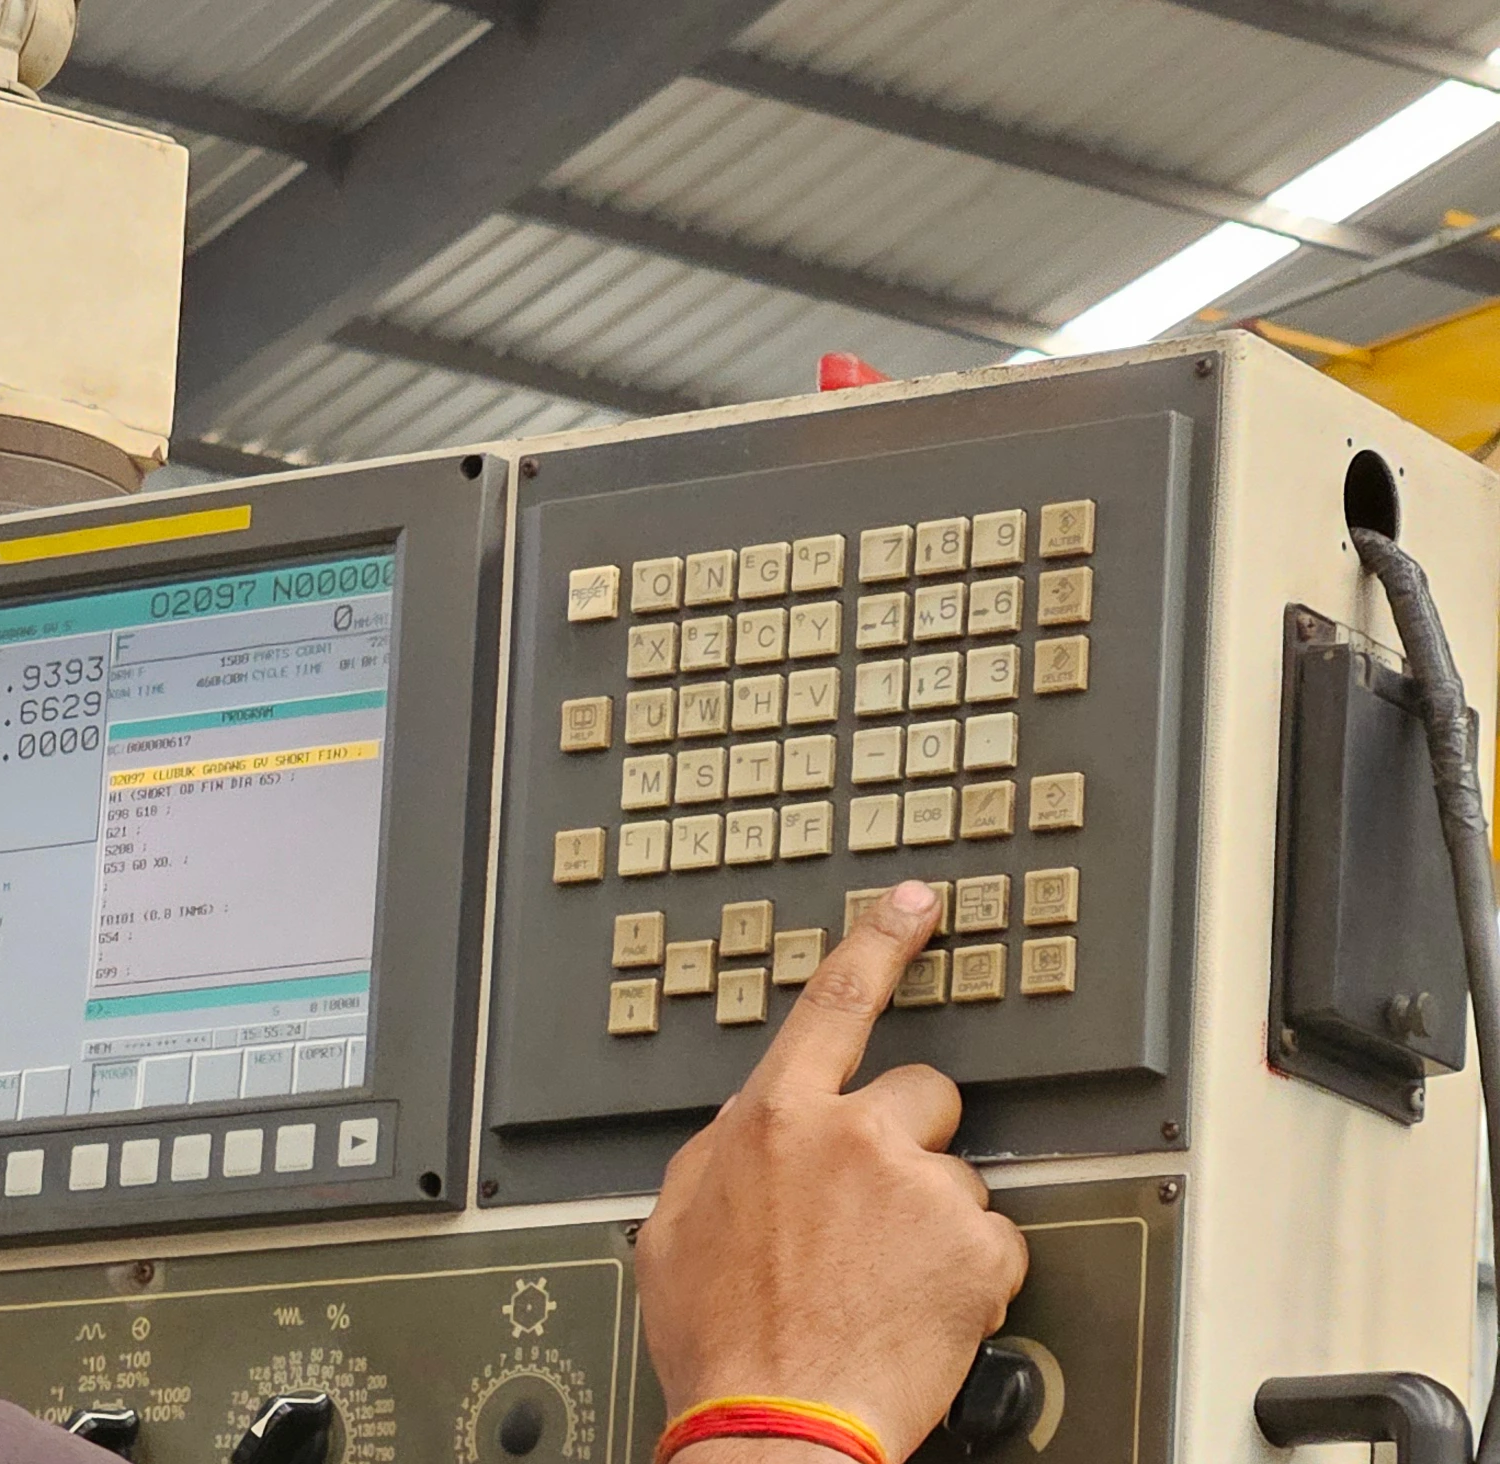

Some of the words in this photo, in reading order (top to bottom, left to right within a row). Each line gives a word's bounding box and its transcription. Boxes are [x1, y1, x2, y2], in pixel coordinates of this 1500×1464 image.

[941, 531, 959, 554] 8
[997, 523, 1016, 546] 9
[1048, 535, 1081, 548] ALTER
[883, 538, 903, 562] 7
[745, 556, 754, 569] E
[761, 560, 778, 582] G
[799, 547, 811, 562] Q
[815, 551, 830, 575] P
[707, 565, 724, 589] N
[571, 585, 608, 600] RESET
[994, 590, 1012, 614] 6
[881, 606, 898, 626] 4
[940, 595, 958, 619] 5
[115, 633, 135, 663] F
[334, 604, 353, 631] 0
[758, 625, 775, 647] C
[811, 618, 828, 641] Y
[633, 634, 644, 648] A
[649, 639, 665, 662] X
[688, 627, 697, 641] B
[703, 632, 721, 656] Z
[252, 650, 290, 663] PARTS
[295, 643, 332, 658] COUNT
[252, 667, 289, 680] CYCLE
[295, 662, 323, 676] TIME
[934, 666, 952, 690] 2
[990, 659, 1009, 682] 3
[882, 673, 893, 696] 1
[754, 692, 771, 715] H
[809, 684, 828, 707] V
[221, 707, 274, 722] PROGRAM
[647, 704, 664, 727] U
[699, 698, 719, 722] W
[569, 730, 594, 741] HELP
[275, 752, 310, 767] SHORT
[318, 748, 348, 761] FIN)
[806, 754, 821, 776] L
[697, 765, 713, 787] S
[750, 758, 769, 781] T
[131, 785, 171, 801] (SHORT
[201, 780, 223, 793] FIN
[230, 776, 252, 788] DIA
[259, 772, 281, 787] 65)
[641, 771, 660, 795] M
[913, 808, 941, 823] EOB
[973, 816, 996, 828] CAN
[106, 827, 127, 839] G21
[746, 826, 762, 849] R
[804, 819, 821, 842] F
[692, 832, 709, 856] K
[563, 859, 588, 871] SHIFT
[99, 932, 119, 944] G54
[959, 980, 994, 992] GRAPH
[254, 1052, 282, 1065] NEXT
[300, 1046, 343, 1062] (OPRT)
[326, 1303, 350, 1330] %
[500, 1353, 507, 1367] 7
[515, 1347, 523, 1361] 8
[531, 1346, 539, 1360] 9
[545, 1349, 559, 1363] 10
[484, 1364, 492, 1378] 6
[560, 1359, 572, 1373] 11
[78, 1375, 111, 1392] 25%
[116, 1371, 150, 1389] 50%
[366, 1374, 388, 1390] 200
[571, 1371, 585, 1385] 12
[355, 1404, 374, 1420] 120
[461, 1397, 469, 1410] 4
[143, 1404, 186, 1423] 100%
[227, 1411, 235, 1424] 5
[237, 1415, 250, 1428] 30
[581, 1409, 595, 1423] 14
[357, 1422, 376, 1437] 130
[376, 1421, 396, 1437] 500
[456, 1417, 464, 1430] 3
[454, 1435, 463, 1450] 2
[581, 1428, 595, 1442] 15
[357, 1444, 374, 1458] 140
